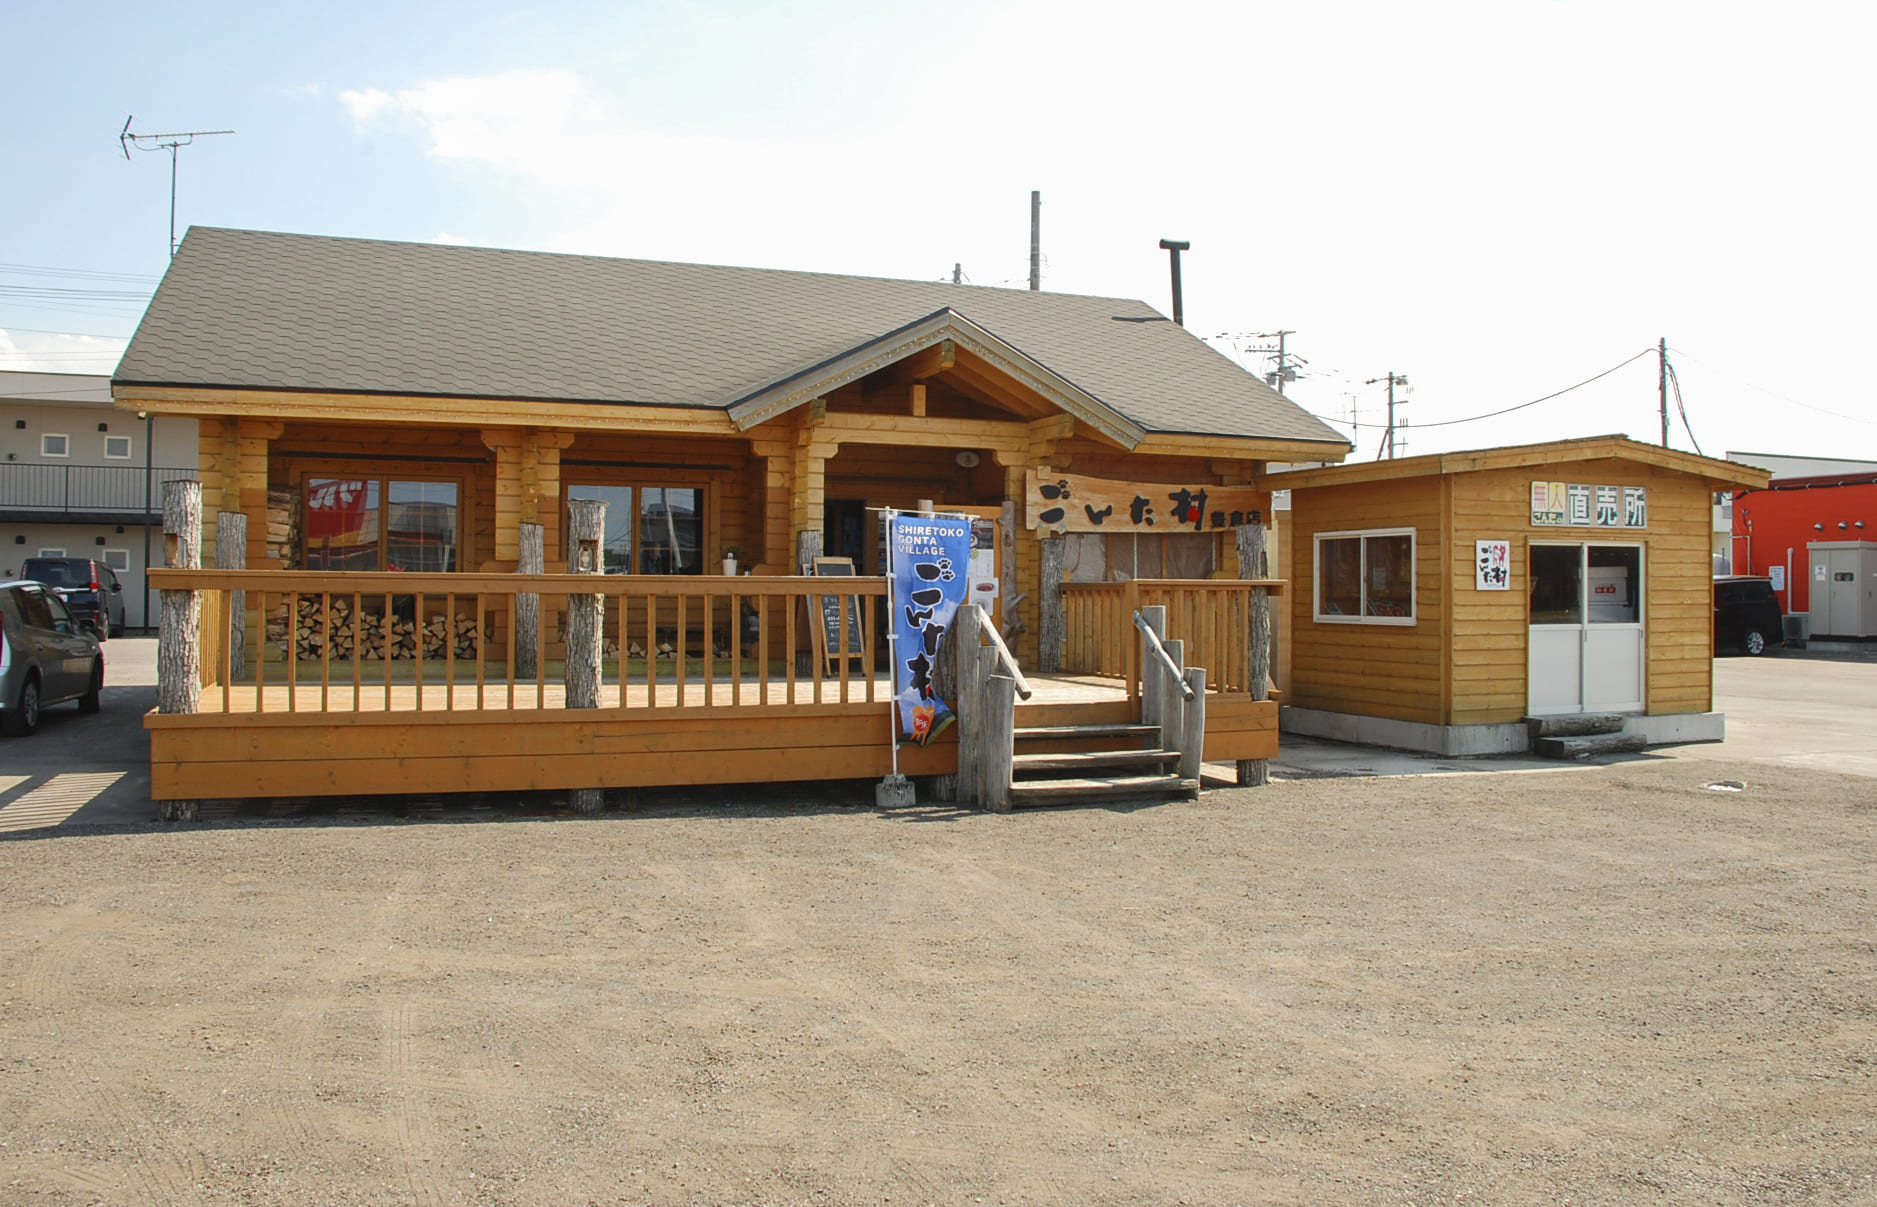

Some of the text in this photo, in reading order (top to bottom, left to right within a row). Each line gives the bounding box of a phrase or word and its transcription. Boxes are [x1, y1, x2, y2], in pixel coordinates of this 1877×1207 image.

[1040, 480, 1208, 530] ごんた村
[1534, 484, 1646, 526] 無人 直売所
[898, 525, 965, 538] SHIRETOKO
[898, 535, 937, 546] GONTA
[898, 545, 945, 556] VILLAGE
